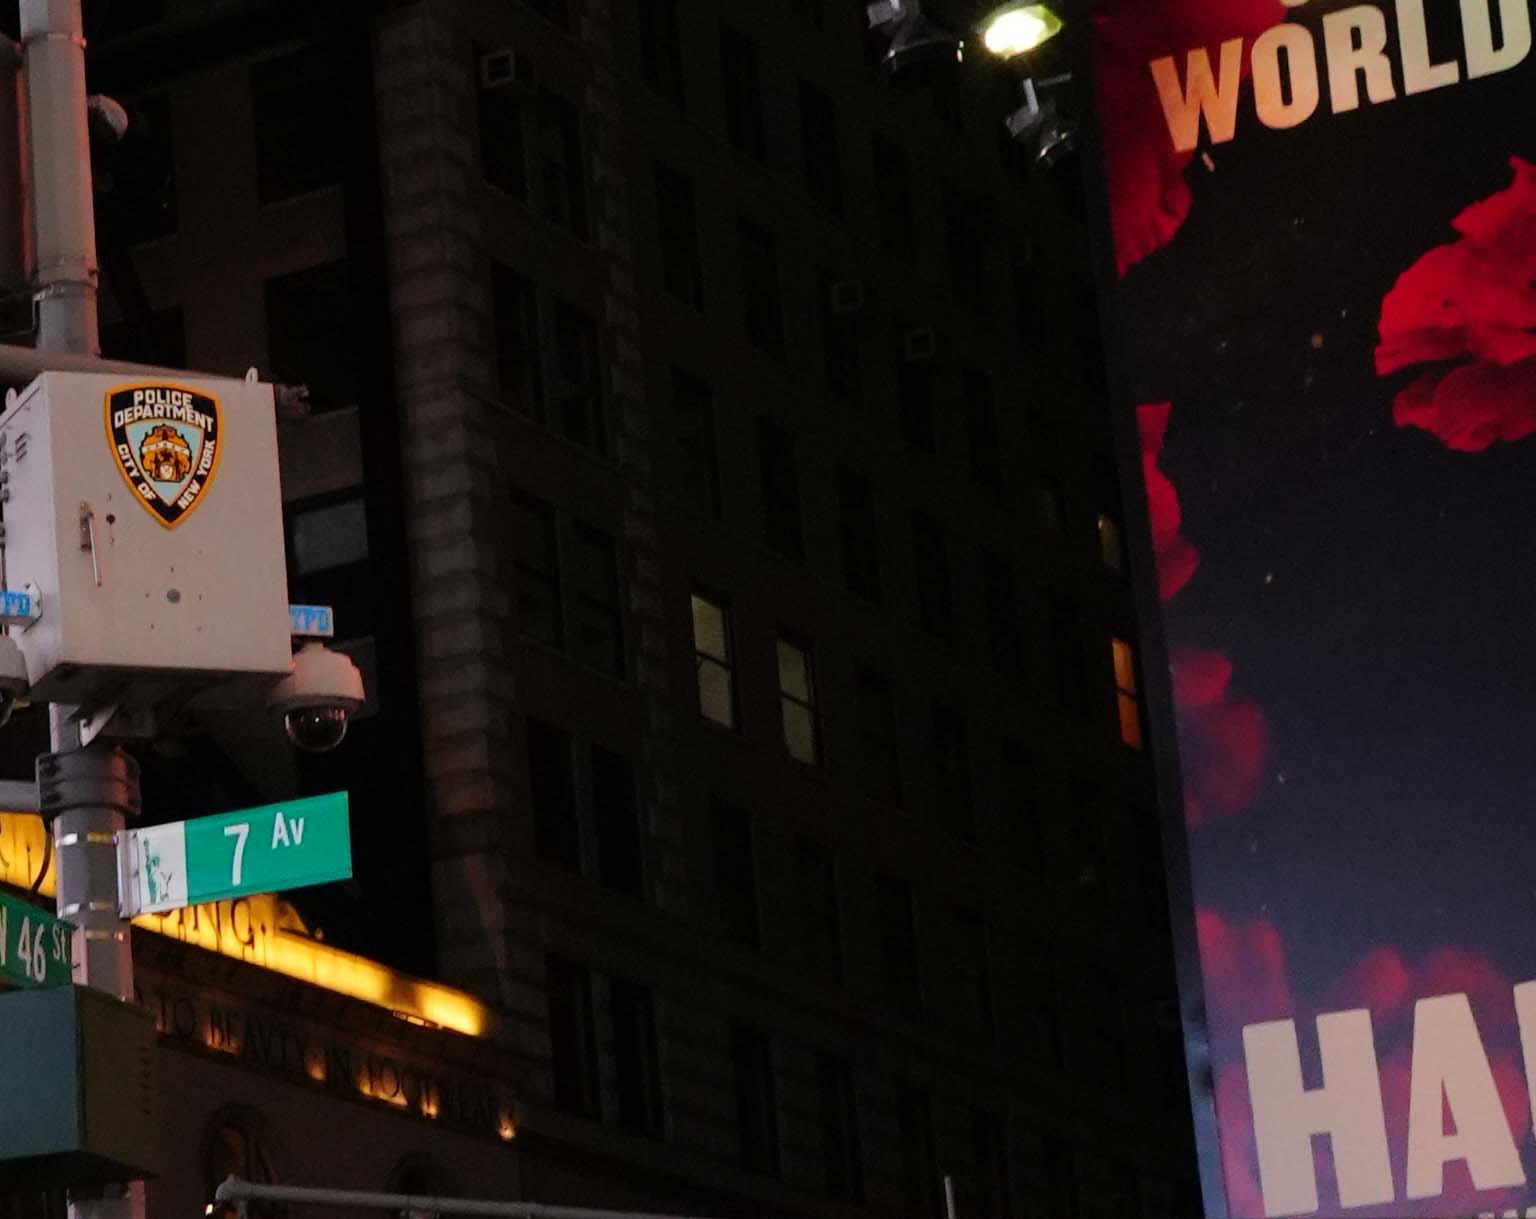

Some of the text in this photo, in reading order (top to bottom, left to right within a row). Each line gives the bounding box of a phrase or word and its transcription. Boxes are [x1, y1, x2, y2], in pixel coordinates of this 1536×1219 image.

[1149, 0, 1532, 153] WORLD
[114, 404, 214, 433] DEPARTMENT
[133, 389, 193, 407] POLICE
[117, 439, 216, 510] CITY OF NEW YORK
[223, 812, 305, 887] 7 Av
[16, 915, 47, 983] 46
[52, 921, 68, 963] St
[1242, 978, 1536, 1219] HA
